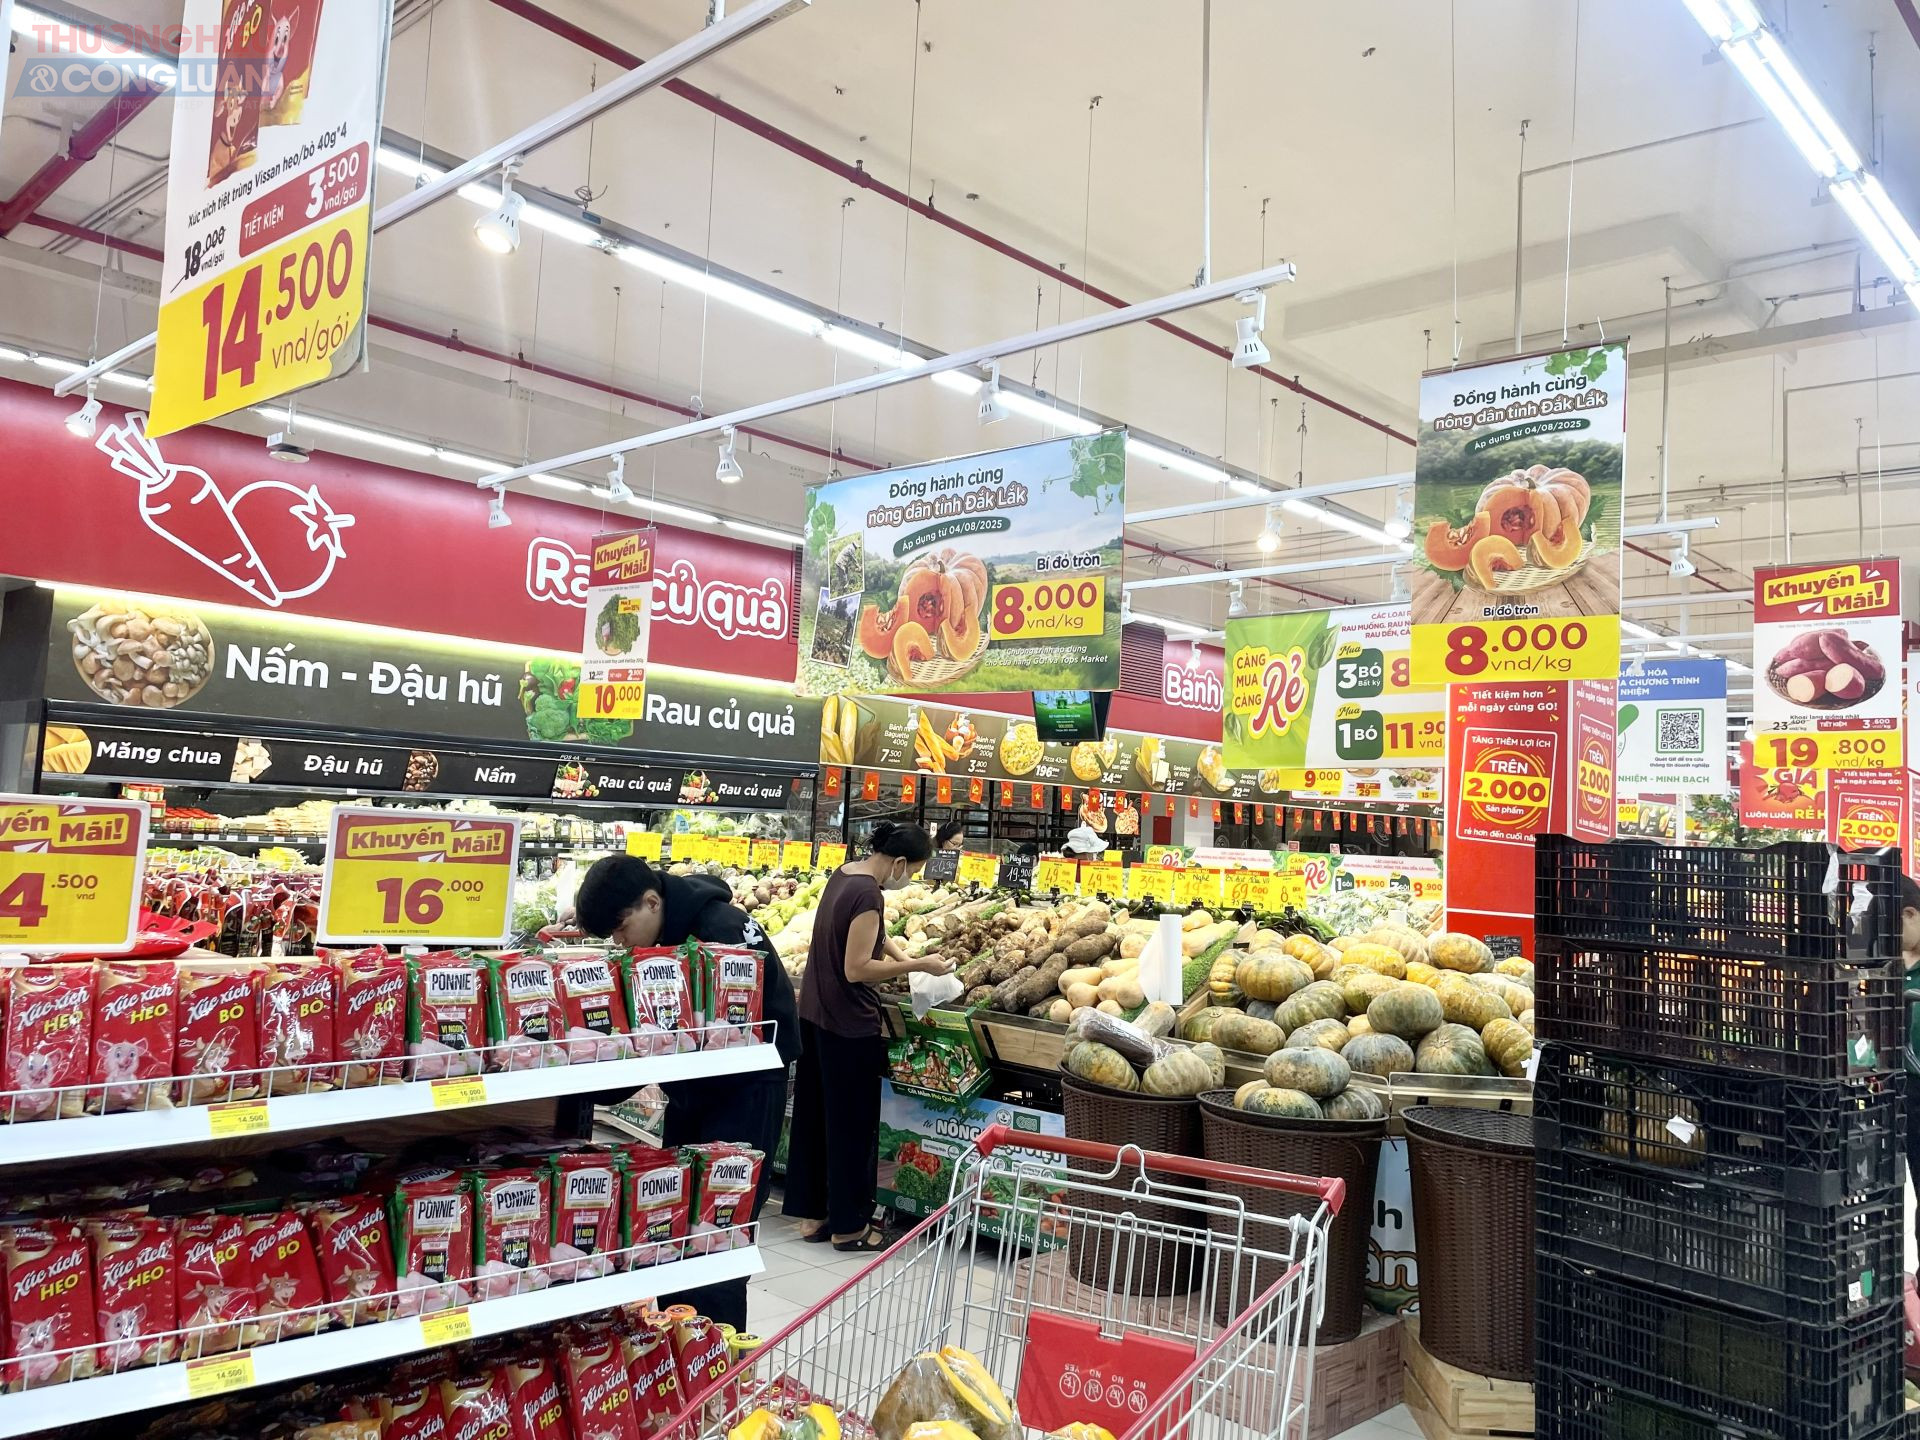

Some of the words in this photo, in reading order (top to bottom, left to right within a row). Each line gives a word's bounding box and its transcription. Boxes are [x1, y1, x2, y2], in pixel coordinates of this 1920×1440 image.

[203, 199, 217, 216] xích
[217, 192, 231, 212] tiệt
[232, 182, 253, 202] trùng
[254, 166, 281, 189] Vissan
[282, 142, 316, 175] heo/bò
[324, 186, 358, 213] vnd/gói
[244, 211, 263, 239] TIẾT
[264, 204, 285, 234] KIỆM
[272, 312, 350, 369] vnd/gói
[1453, 389, 1497, 407] Đồng
[1500, 381, 1541, 399] hành
[1545, 375, 1588, 393] cùng
[1435, 414, 1474, 430] nông
[1476, 407, 1505, 424] dân
[1507, 401, 1537, 419] tỉnh
[1541, 396, 1573, 414] Đắk
[1576, 390, 1606, 408] Lắk
[1488, 431, 1511, 445] dụng
[1513, 428, 1523, 437] từ
[1524, 419, 1582, 435] 04/08/2025
[889, 479, 927, 498] Đồng
[930, 474, 964, 492] hành
[968, 467, 1004, 485] cùng
[868, 506, 903, 526] nông
[905, 501, 931, 520] dân
[934, 494, 961, 516] tỉnh
[965, 487, 995, 512] Đắk
[998, 483, 1026, 506] Lắk
[915, 531, 936, 547] dụng
[938, 525, 947, 537] từ
[949, 519, 1003, 535] 04/08/2025
[596, 540, 637, 565] Khuyến
[1036, 554, 1050, 571] Bí
[1051, 552, 1070, 571] đỏ
[1071, 552, 1101, 568] tròn
[1767, 571, 1856, 600] Khuyến
[1832, 582, 1885, 612] Mãi!
[651, 567, 693, 617] củ
[706, 585, 782, 631] quả
[993, 581, 1098, 635] 8.000
[1483, 606, 1495, 617] Bí
[1496, 604, 1513, 617] đỏ
[1514, 604, 1539, 616] tròn
[1026, 613, 1084, 630] vnd/kg
[1342, 624, 1357, 632] RAU
[1061, 655, 1079, 665] Tops
[1081, 654, 1109, 663] Market
[1444, 622, 1589, 676] 8.000
[1236, 653, 1267, 670] CÀNG
[1490, 656, 1573, 673] vnd/kg
[1647, 667, 1668, 676] HÓA
[225, 642, 330, 690] Nấm
[368, 660, 449, 707] Đậu
[457, 669, 503, 708] hũ
[1236, 675, 1259, 688] MUA
[1337, 663, 1358, 689] 3
[1358, 662, 1382, 678] BÓ
[1628, 677, 1669, 686] CHƯƠNG
[1671, 675, 1700, 685] TRÌNH
[594, 684, 642, 714] 10.000
[1165, 668, 1221, 707] Bánh
[1252, 653, 1306, 731] Rẻ
[1471, 690, 1493, 700] Tiết
[1494, 689, 1522, 701] kiệm
[1523, 689, 1544, 699] hơn
[1620, 687, 1650, 696] NHIỆM
[1234, 693, 1262, 709] CÀNG
[1457, 702, 1478, 712] mỗi
[1479, 703, 1505, 714] ngày
[1507, 702, 1534, 713] cùng
[1537, 702, 1558, 711] GO!
[645, 693, 701, 727] Rau
[708, 697, 740, 732] củ
[746, 704, 796, 738] quả
[1338, 723, 1352, 749] 1
[1354, 725, 1378, 741] BÓ
[1471, 734, 1494, 745] TĂNG
[1496, 736, 1518, 746] THÊM
[1519, 737, 1535, 749] LỢI
[1536, 737, 1551, 748] ÍCH
[95, 740, 165, 767] Măng
[167, 744, 222, 767] chua
[1588, 749, 1605, 766] TRÊN
[1769, 737, 1819, 768] 19
[303, 754, 352, 778] Đậu
[353, 756, 384, 776] hũ
[474, 765, 517, 784] Nấm
[1489, 758, 1529, 774] TRÊN
[598, 775, 625, 789] Rau
[627, 775, 645, 790] củ
[646, 776, 672, 792] quả
[717, 783, 742, 796] Rau
[743, 783, 759, 797] củ
[760, 784, 783, 799] quả
[1304, 770, 1341, 788] 9.000
[1466, 778, 1547, 802] 2.000
[1579, 766, 1611, 794] 2.000
[1617, 774, 1648, 784] NHIỆM
[1682, 776, 1710, 785] BẠCH
[1485, 803, 1501, 814] Sản
[1501, 804, 1525, 816] phẩm
[1745, 811, 1768, 819] LUÔN
[1769, 811, 1793, 819] LUÔN
[1794, 805, 1815, 820] RẺ
[1856, 811, 1884, 822] TRÊN
[59, 817, 125, 842] Mãi!
[351, 825, 446, 850] Khuyến
[452, 833, 502, 854] Mãi!
[1841, 822, 1896, 837] 2.000
[103, 992, 139, 1021] Xúc
[140, 982, 174, 1003] xích
[187, 995, 219, 1025] Xúc
[220, 982, 251, 1003] xích
[218, 1002, 245, 1024] BÒ
[130, 1003, 168, 1025] HEO
[237, 1114, 264, 1123] 14.500
[936, 1117, 982, 1141] NÔNG
[249, 1234, 277, 1262] Xúc
[276, 1218, 304, 1240] xích
[277, 1239, 301, 1260] BÒ
[13, 1270, 47, 1301] Xúc
[47, 1249, 83, 1276] xích
[39, 1273, 79, 1301] HEO
[686, 1357, 707, 1382] Xúc
[706, 1338, 728, 1362] xích
[708, 1359, 727, 1380] BÒ
